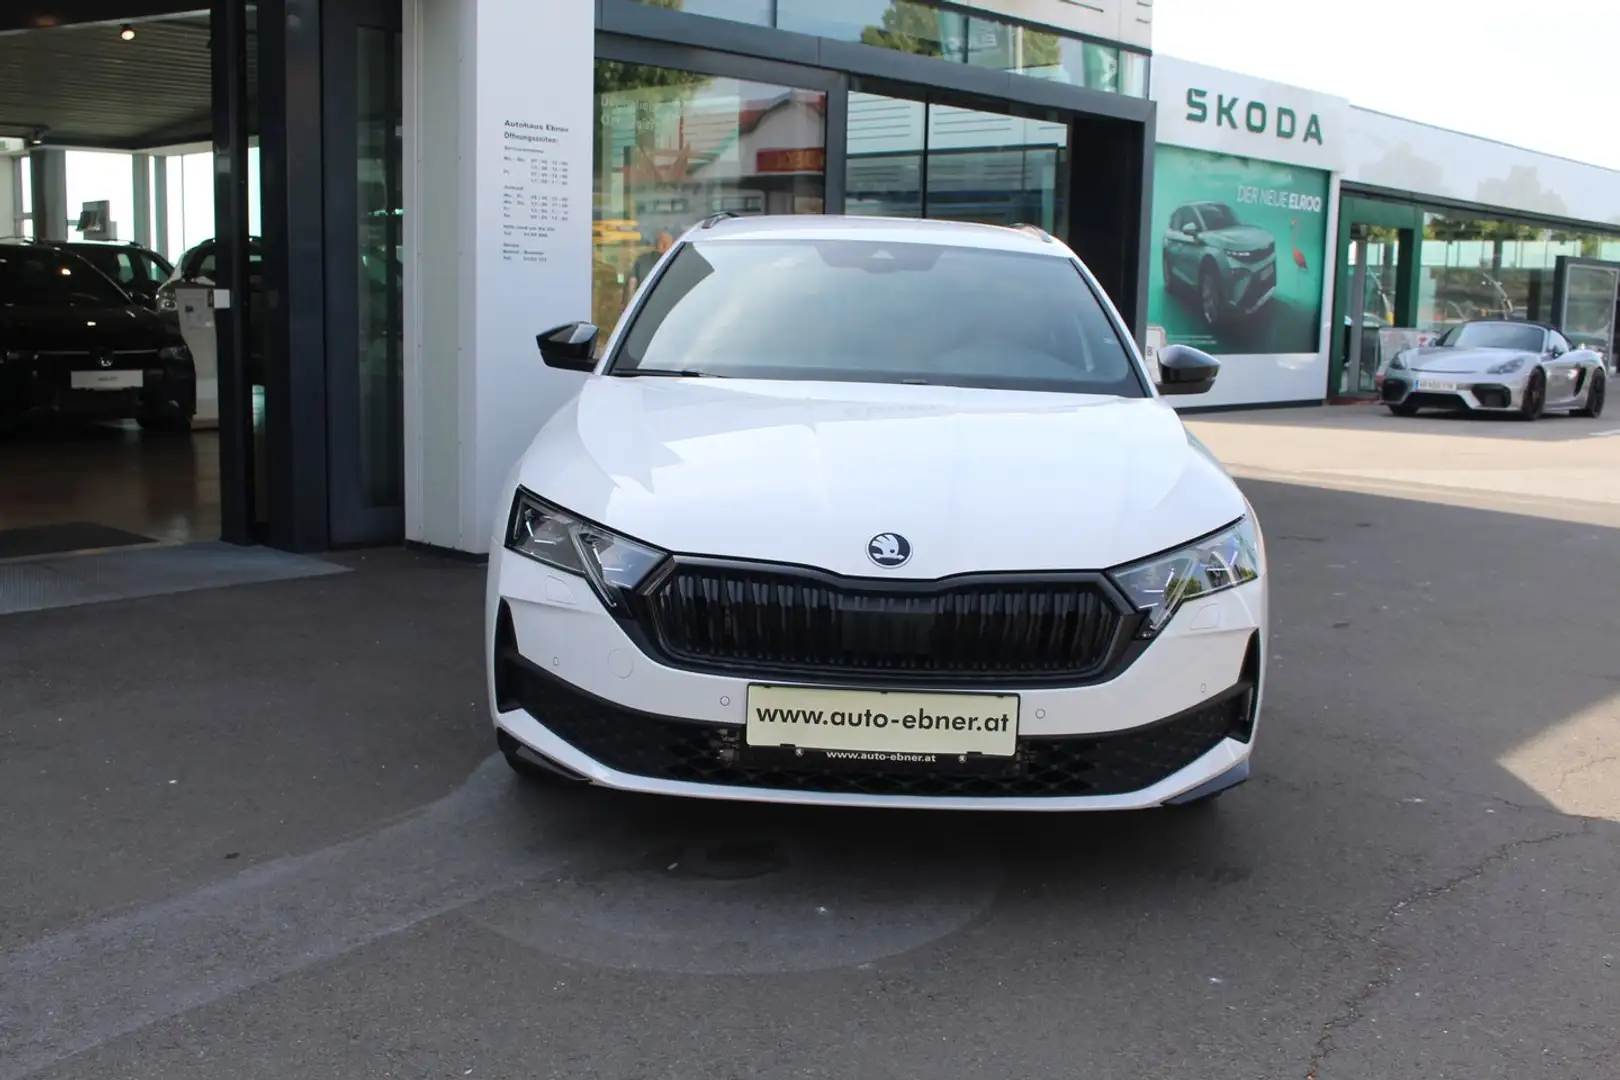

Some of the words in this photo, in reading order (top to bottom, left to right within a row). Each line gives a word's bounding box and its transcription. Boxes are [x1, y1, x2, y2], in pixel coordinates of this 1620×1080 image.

[504, 119, 544, 131] Autohaus
[545, 123, 569, 133] Ebner
[1237, 185, 1260, 204] DER
[1261, 189, 1289, 208] NEUE
[1289, 193, 1322, 212] ELROQ
[756, 707, 1009, 733] www.auto-ebner.at
[826, 750, 937, 764] www.auto-ebner.at
